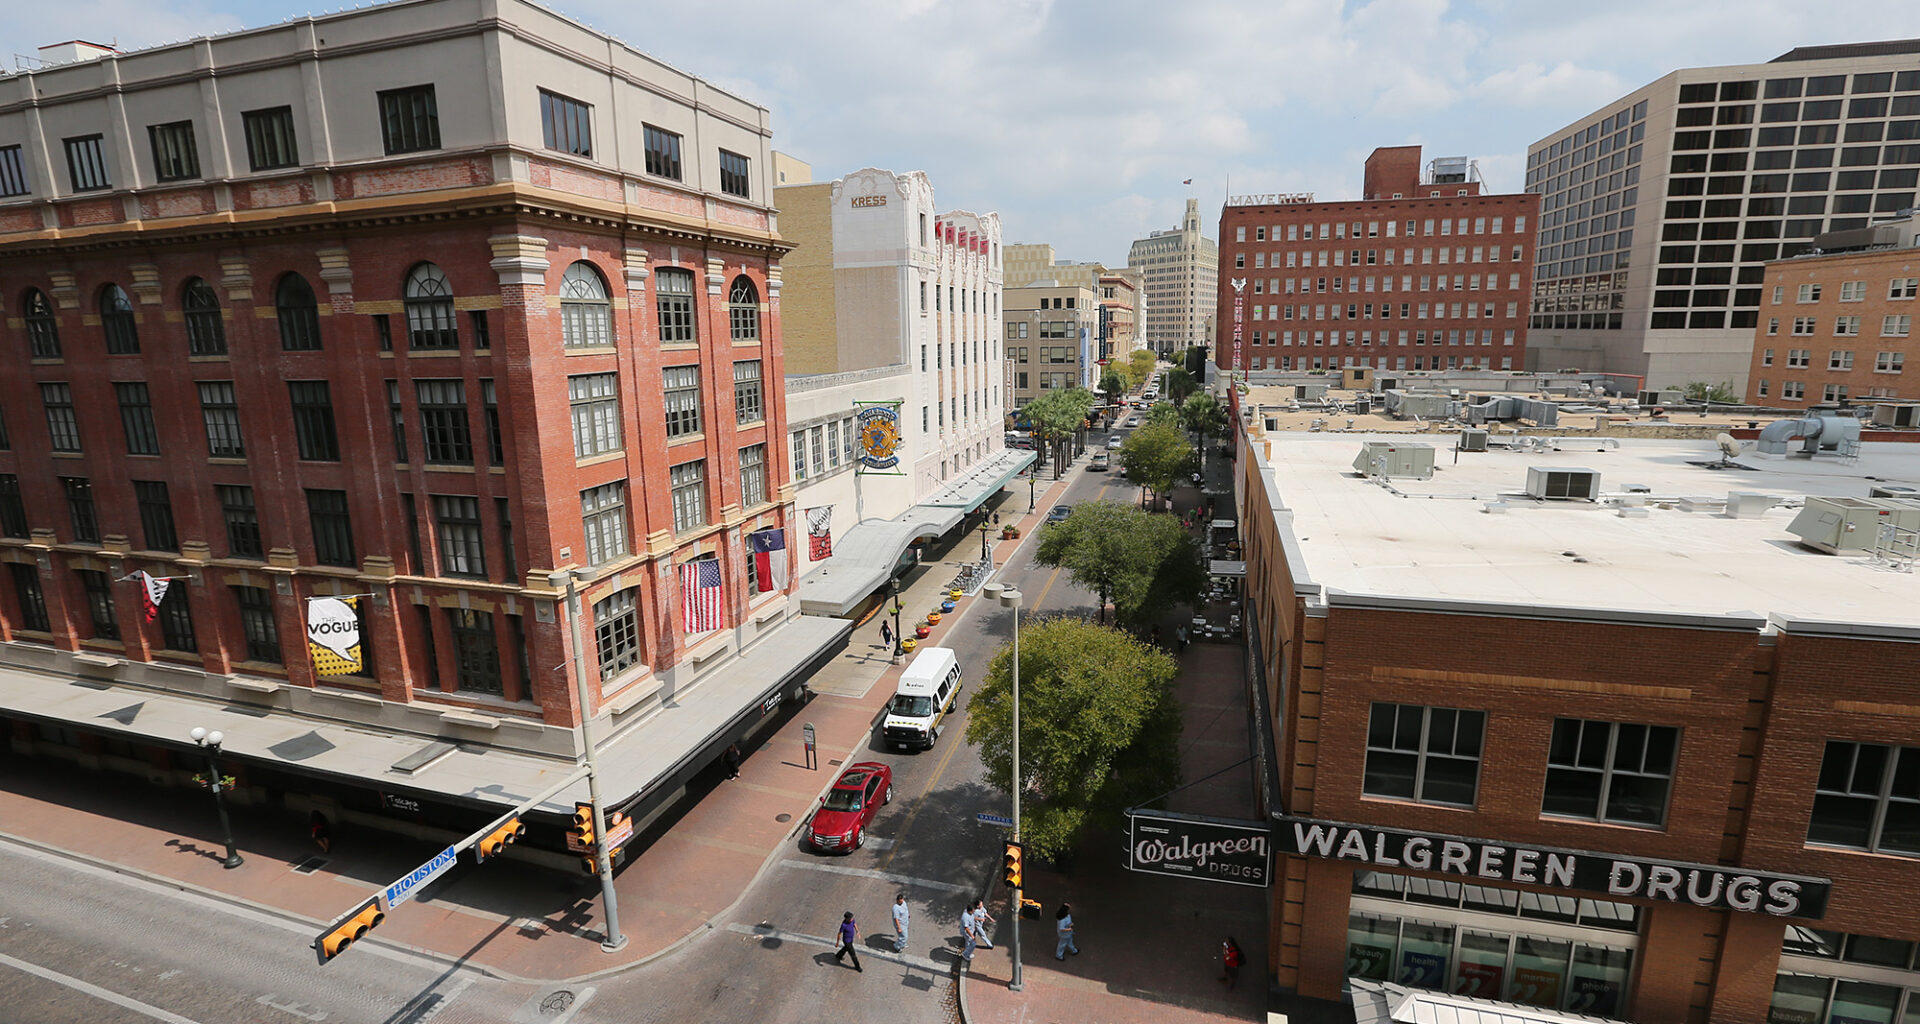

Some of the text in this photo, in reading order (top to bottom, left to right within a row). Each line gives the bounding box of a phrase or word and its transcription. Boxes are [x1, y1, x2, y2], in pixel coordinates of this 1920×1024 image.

[851, 196, 887, 208] KRESS
[1230, 192, 1315, 206] MAVERICK
[935, 221, 988, 254] KRESS
[308, 621, 359, 634] VOGUE
[1135, 835, 1267, 866] Walgreen
[393, 849, 451, 898] HOUSTON
[1209, 862, 1263, 878] DRUGS
[1294, 822, 1802, 916] WALGREEN DRUGS
[1355, 947, 1385, 959] beauty
[1411, 955, 1438, 967] health
[1582, 982, 1610, 992] photo
[1772, 1010, 1807, 1023] beauty
